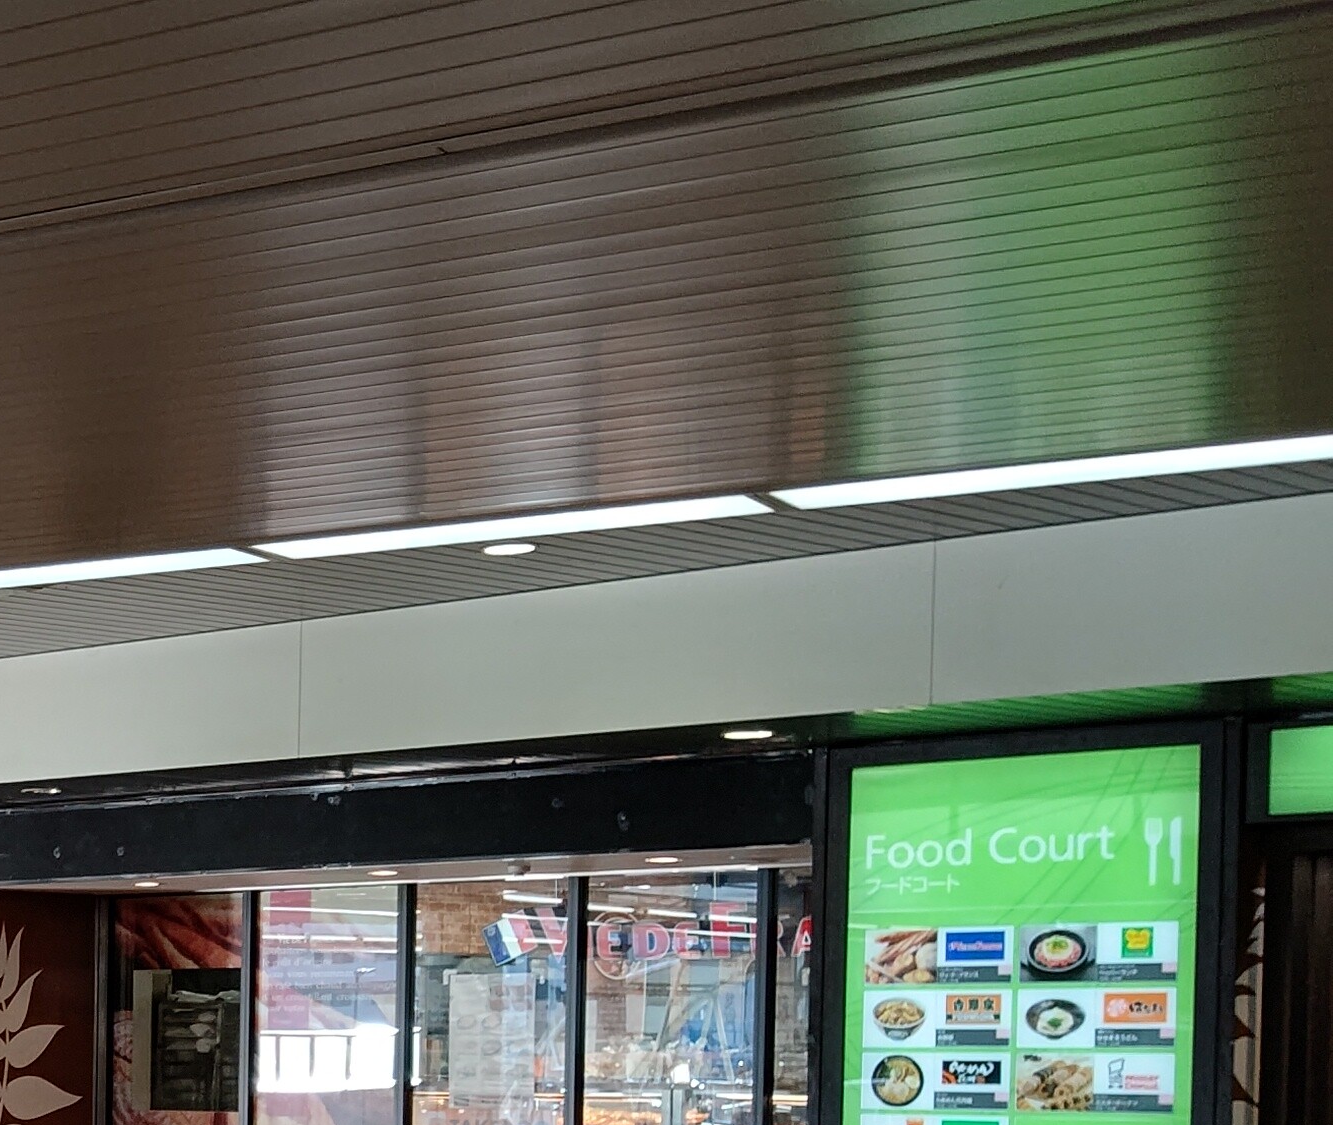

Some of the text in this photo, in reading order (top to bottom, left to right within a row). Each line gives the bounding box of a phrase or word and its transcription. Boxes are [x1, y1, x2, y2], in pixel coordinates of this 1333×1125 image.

[865, 825, 1115, 870] Food Court
[865, 873, 960, 895] フードコート
